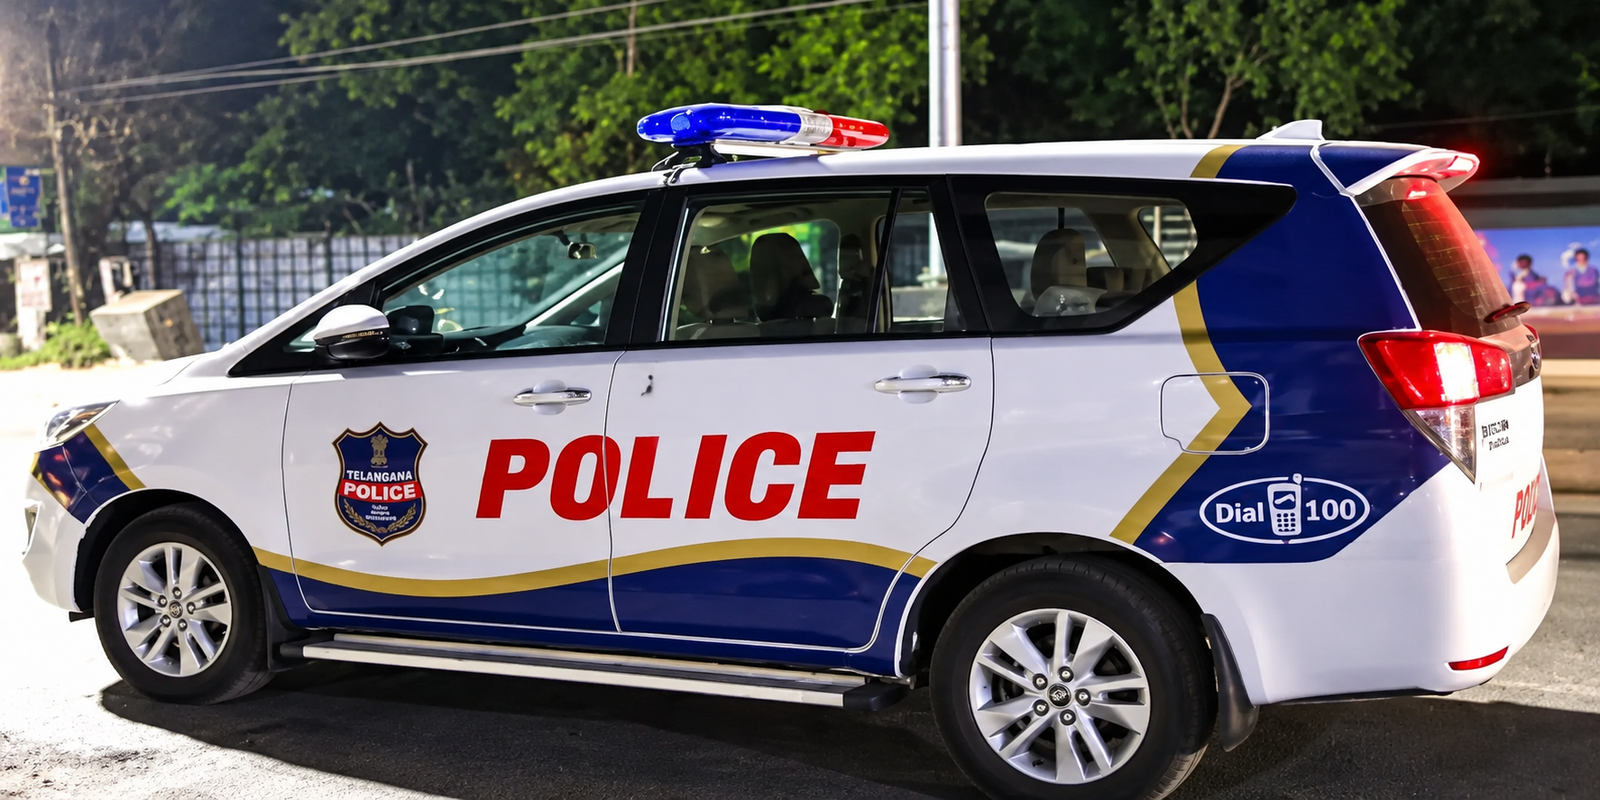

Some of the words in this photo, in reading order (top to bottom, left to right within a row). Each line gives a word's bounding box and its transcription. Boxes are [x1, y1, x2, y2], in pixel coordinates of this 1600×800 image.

[346, 469, 413, 482] TELANGANA
[475, 430, 877, 522] POLICE
[343, 482, 416, 501] POLICE
[1215, 502, 1265, 523] Dial
[1305, 498, 1357, 521] 100
